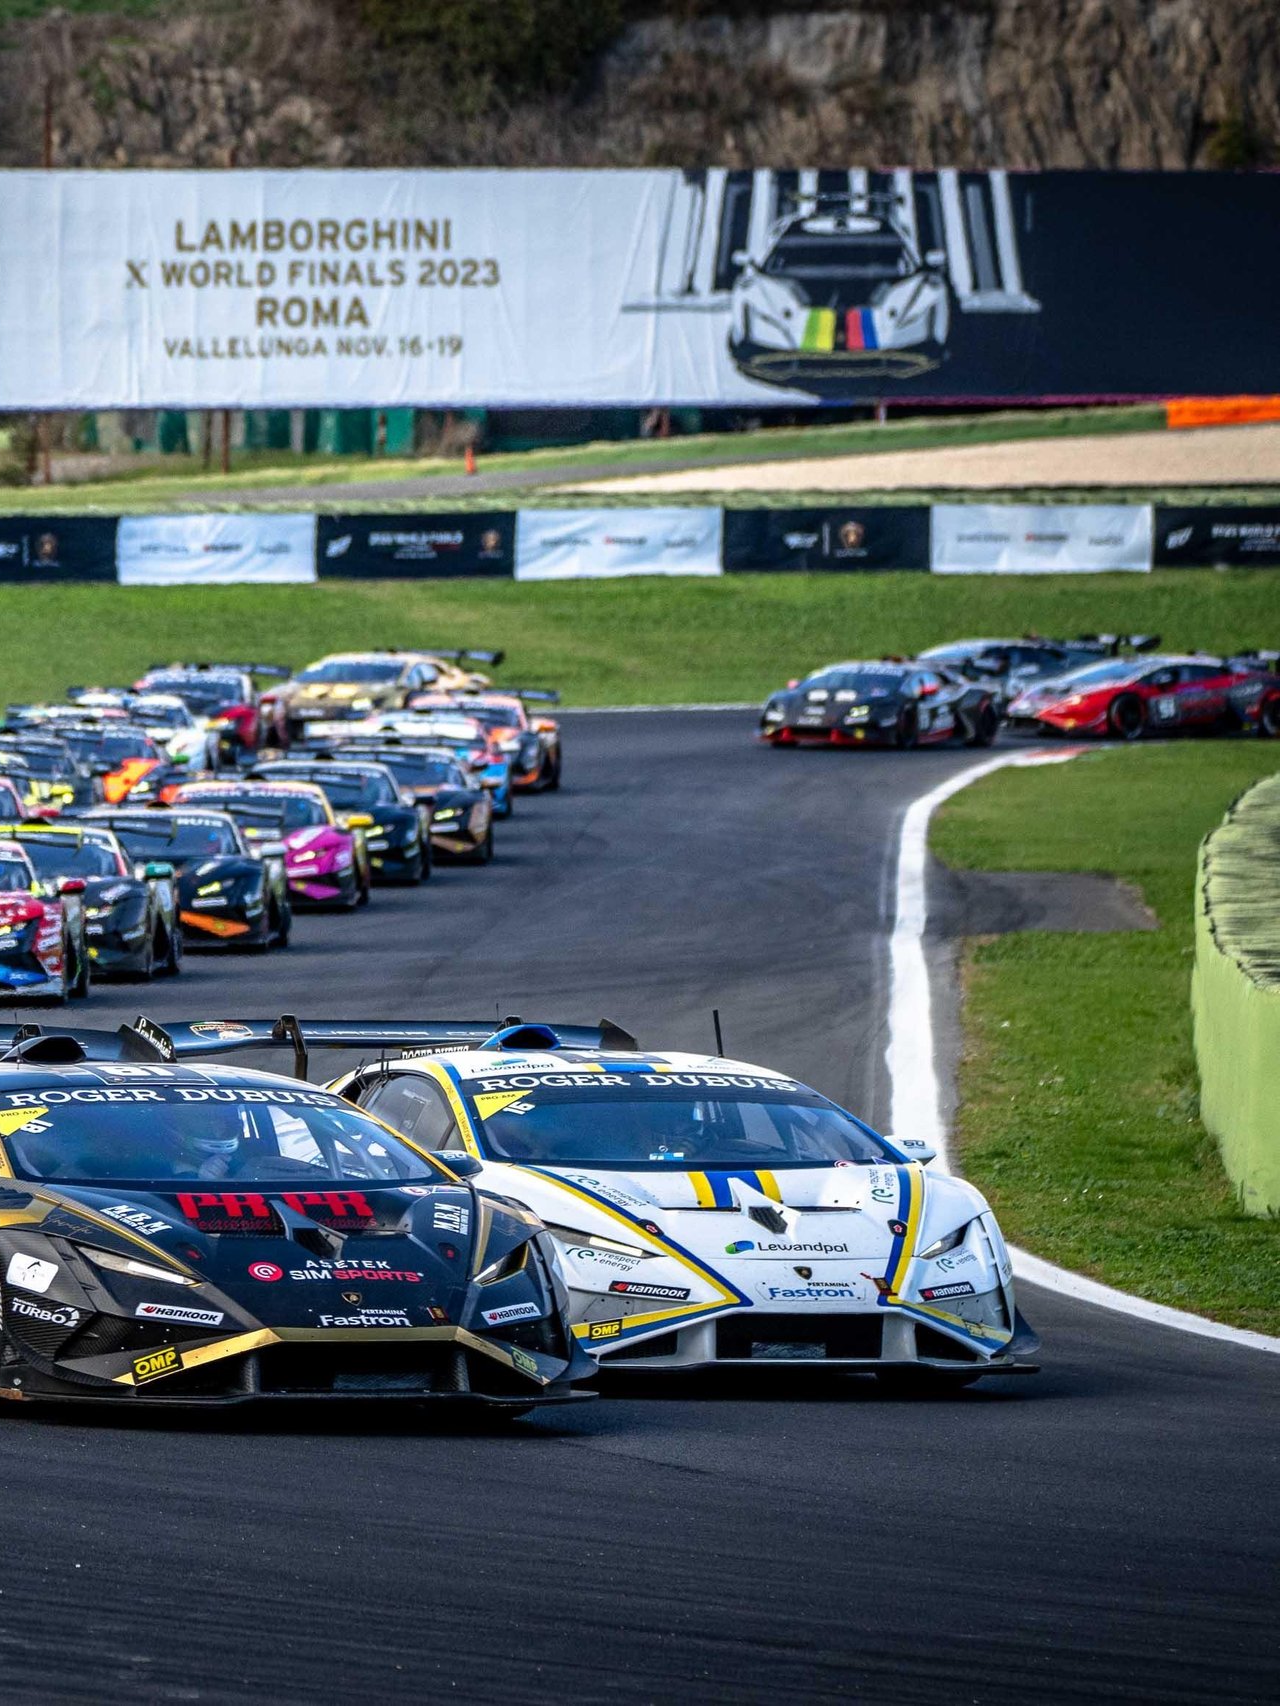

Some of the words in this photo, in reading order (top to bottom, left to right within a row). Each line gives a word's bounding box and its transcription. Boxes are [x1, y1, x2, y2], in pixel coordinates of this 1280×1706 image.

[174, 219, 452, 252] LAMBORGHINI
[126, 260, 148, 288] X
[162, 260, 275, 287] WORLD
[288, 260, 406, 286] FINALS
[417, 259, 500, 286] 2023
[256, 296, 370, 328] ROMA
[164, 337, 328, 358] VALLELUNGA
[336, 337, 392, 357] NOV.
[470, 1063, 554, 1074] Lewandpol
[478, 1074, 630, 1091] ROGER
[639, 1073, 798, 1092] DUBUIS
[6, 1089, 166, 1106] ROGER
[174, 1088, 338, 1107] DUBUIS
[503, 1102, 535, 1115] 16
[20, 1119, 54, 1133] 81
[598, 1187, 632, 1207] energy
[758, 1242, 849, 1254] Lewandpol
[306, 1259, 390, 1270] ASETEK
[599, 1258, 633, 1272] energy
[604, 1252, 641, 1266] respect
[768, 1287, 854, 1298] Fastron
[12, 1301, 68, 1326] TURBO
[361, 1308, 406, 1316] PERTAMINA
[321, 1314, 413, 1327] Fastron
[592, 1324, 620, 1337] OMP
[135, 1351, 177, 1375] OMP
